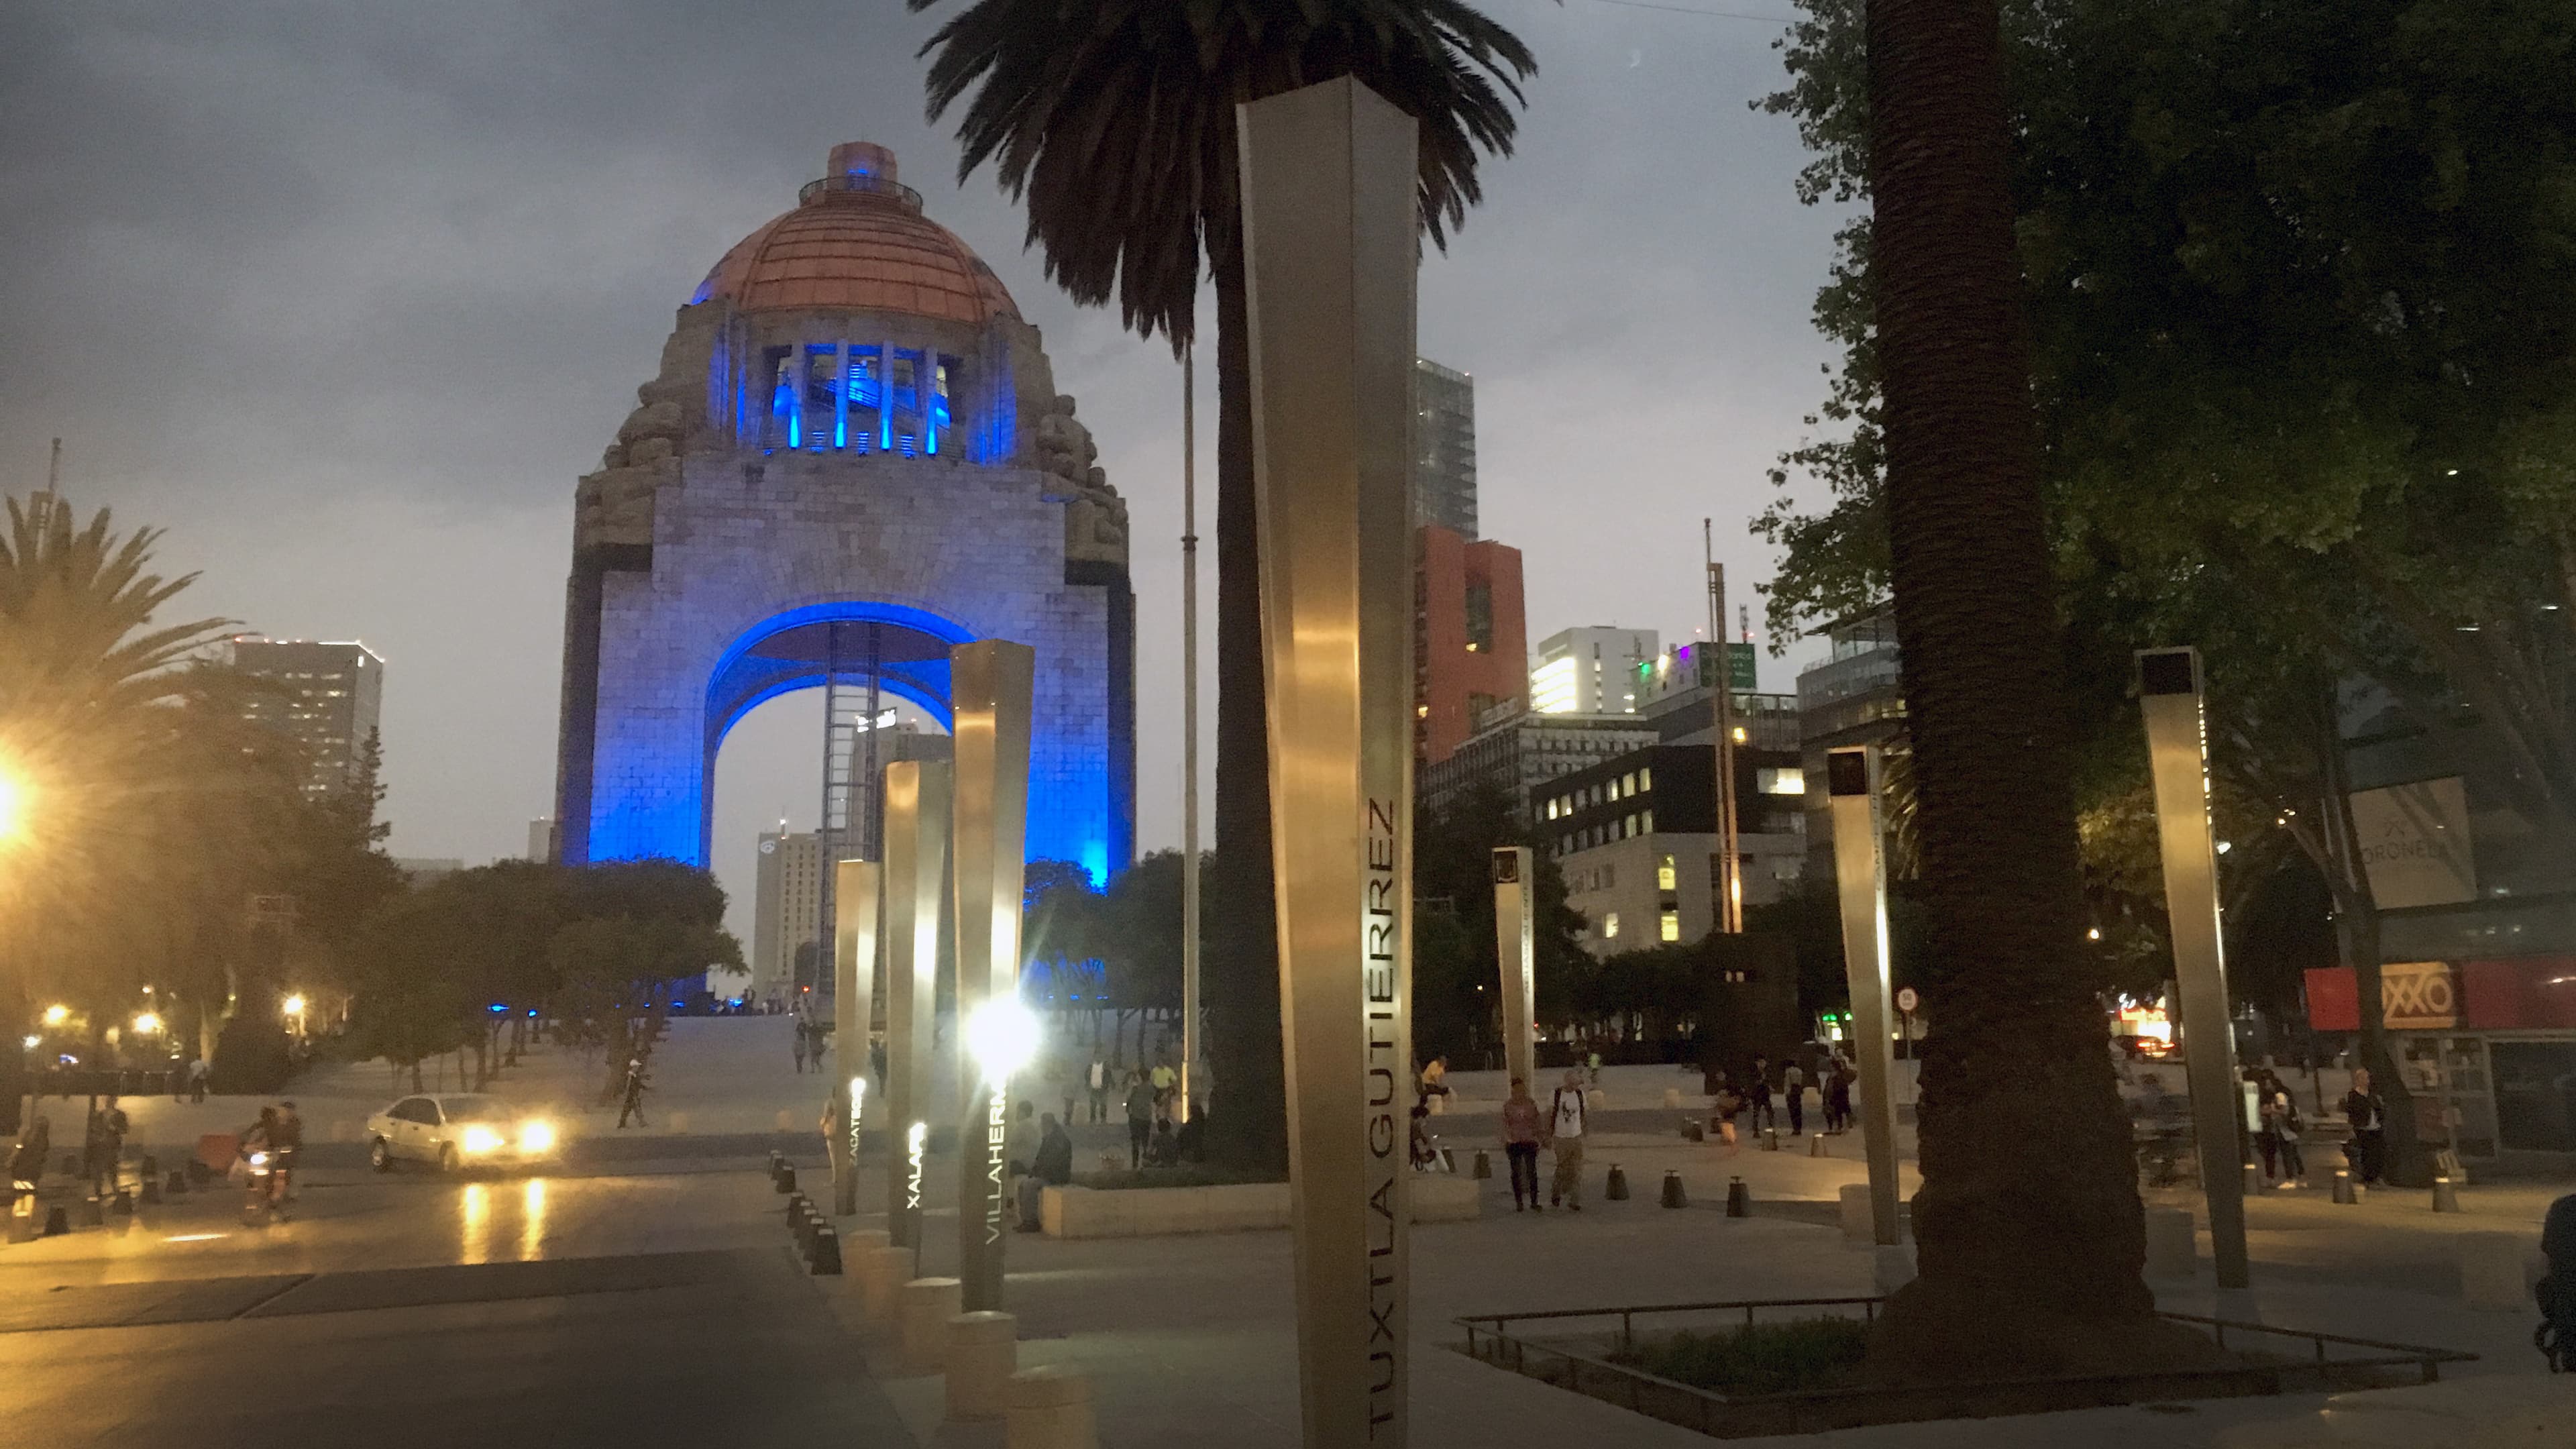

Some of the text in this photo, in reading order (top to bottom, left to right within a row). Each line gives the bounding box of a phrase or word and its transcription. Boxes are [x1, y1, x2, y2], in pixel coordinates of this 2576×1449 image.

[2381, 974, 2453, 1014] XXO
[849, 1078, 863, 1167] ZACATEC
[1368, 797, 1393, 1442] TUXTLA GUTIERREZ
